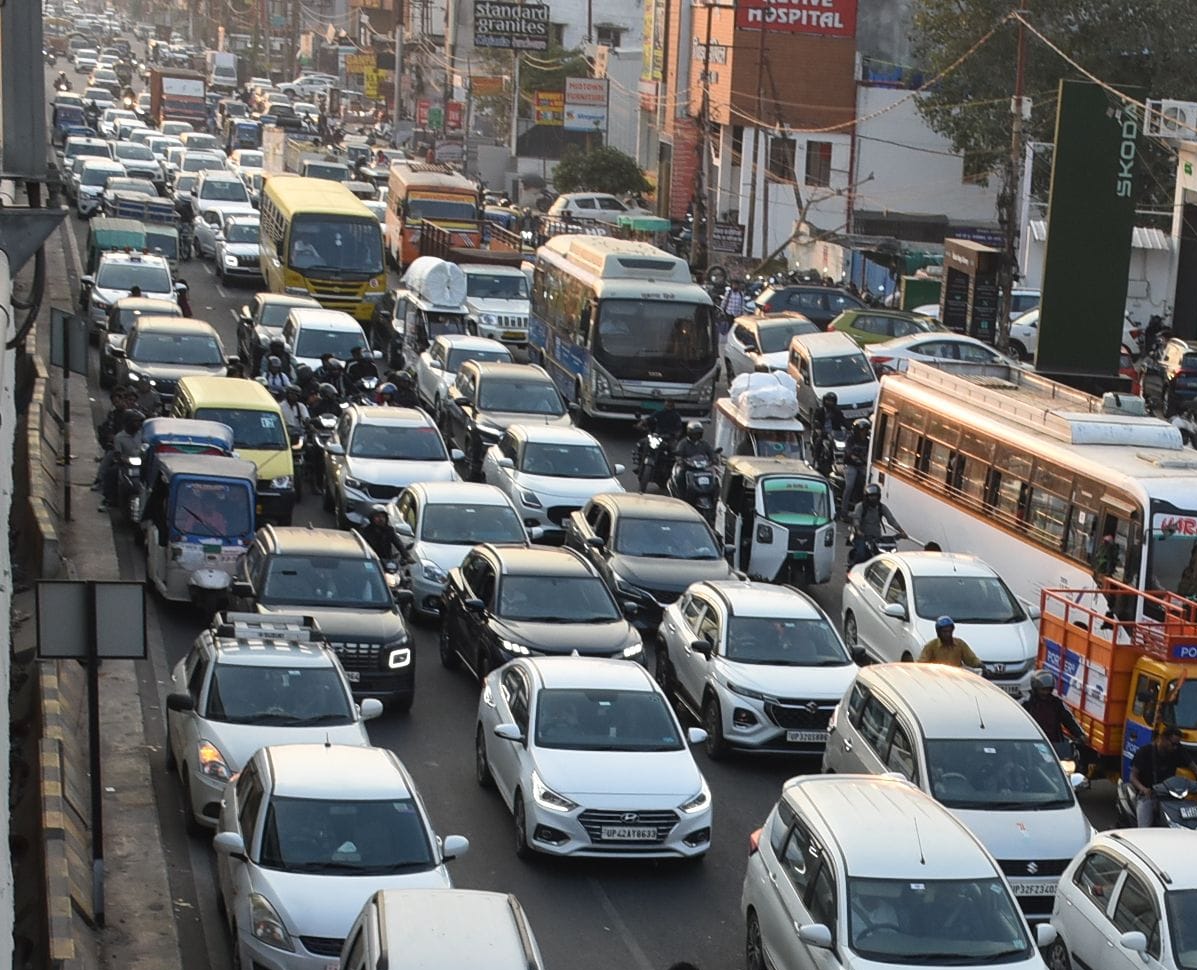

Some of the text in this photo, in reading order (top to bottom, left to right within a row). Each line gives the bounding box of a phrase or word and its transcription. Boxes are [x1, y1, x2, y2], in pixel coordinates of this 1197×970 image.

[475, 2, 548, 20] standard
[747, 7, 843, 28] HOSPITAL
[478, 18, 546, 34] granites
